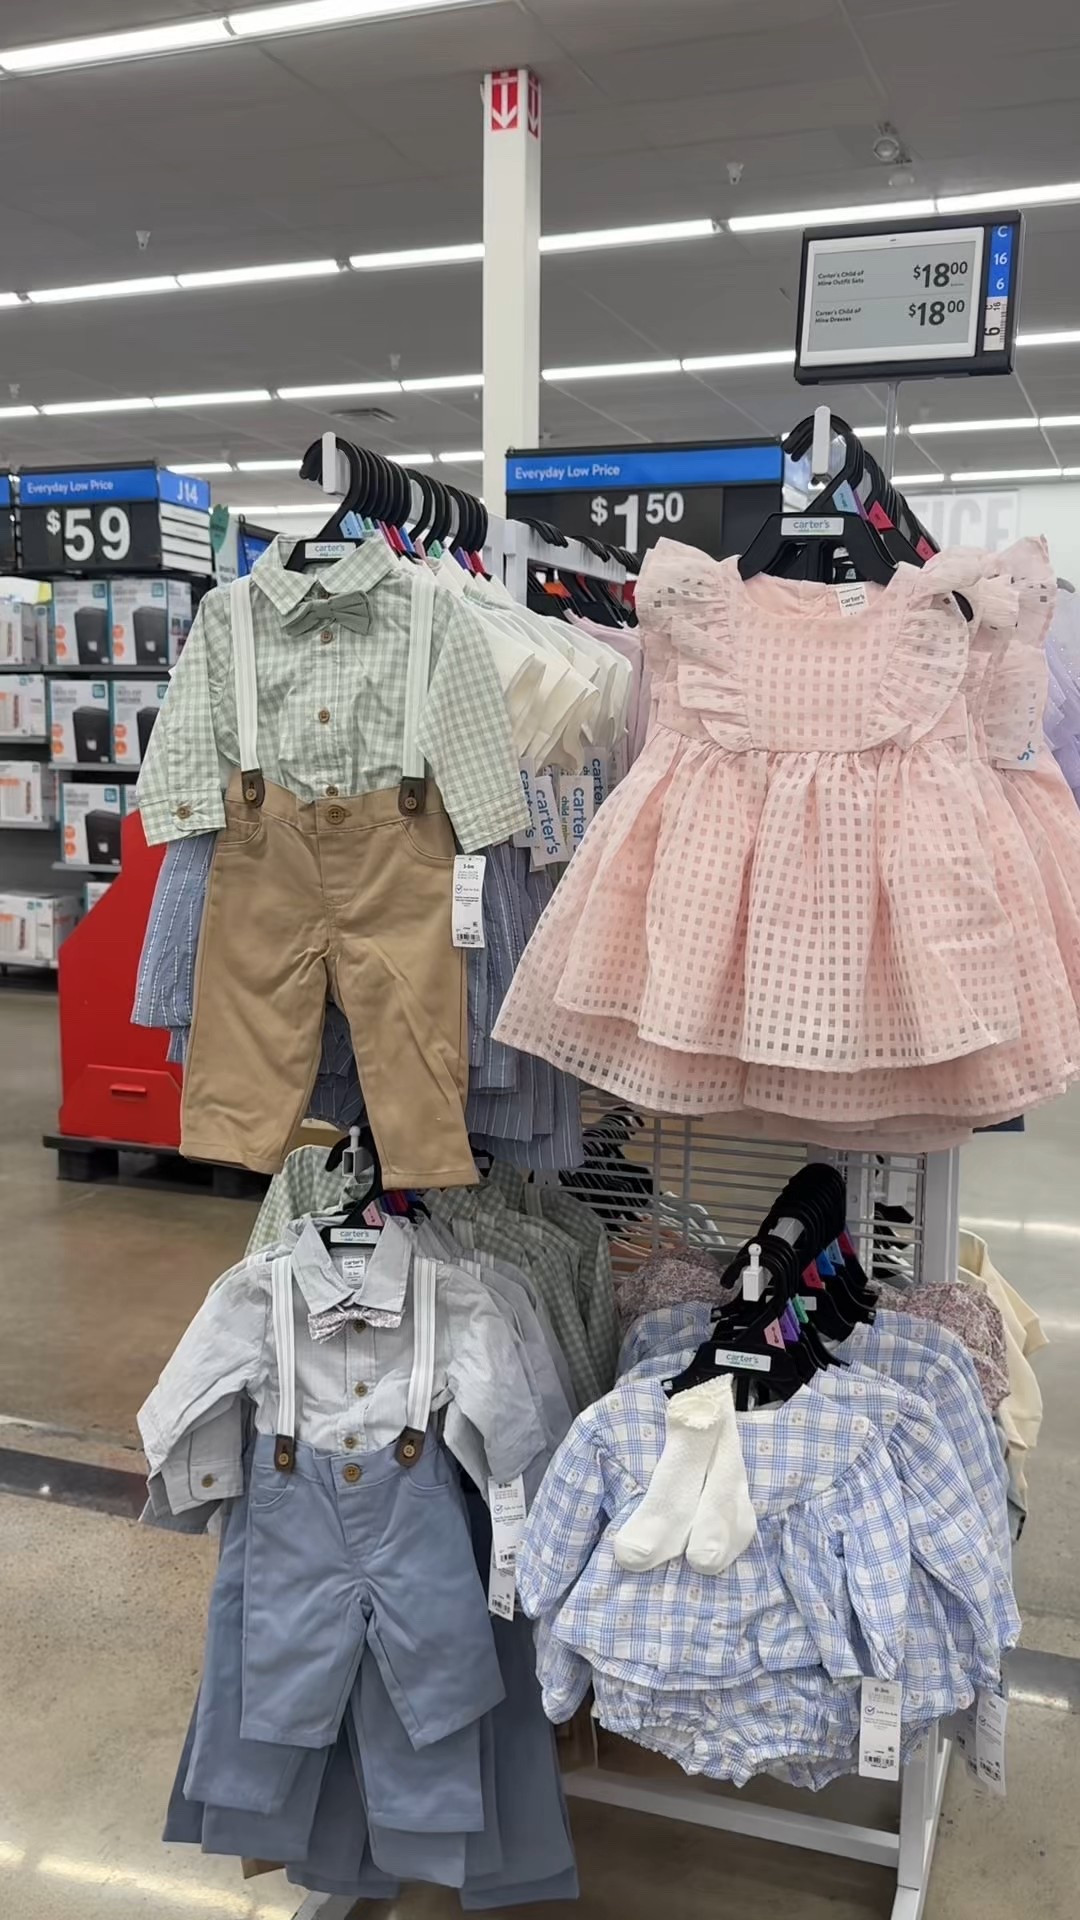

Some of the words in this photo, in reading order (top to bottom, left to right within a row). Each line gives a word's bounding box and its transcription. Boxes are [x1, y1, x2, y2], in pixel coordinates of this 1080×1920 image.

[997, 225, 1008, 238] C
[994, 252, 1008, 265] 16
[817, 272, 840, 280] Carter's
[996, 278, 1005, 290] 6
[515, 466, 564, 481] Everyday
[567, 465, 590, 478] Low
[592, 463, 620, 478] Price
[27, 482, 69, 496] Everyday
[70, 482, 88, 493] Low
[90, 480, 114, 492] Price
[176, 480, 198, 504] J14
[793, 520, 830, 529] carter's
[46, 506, 130, 562] $59
[314, 543, 345, 552] carter's
[840, 594, 865, 604] carter's
[592, 758, 605, 805] carter
[536, 789, 561, 855] carter's
[340, 1229, 370, 1238] carter's
[726, 1353, 759, 1364] carter's
